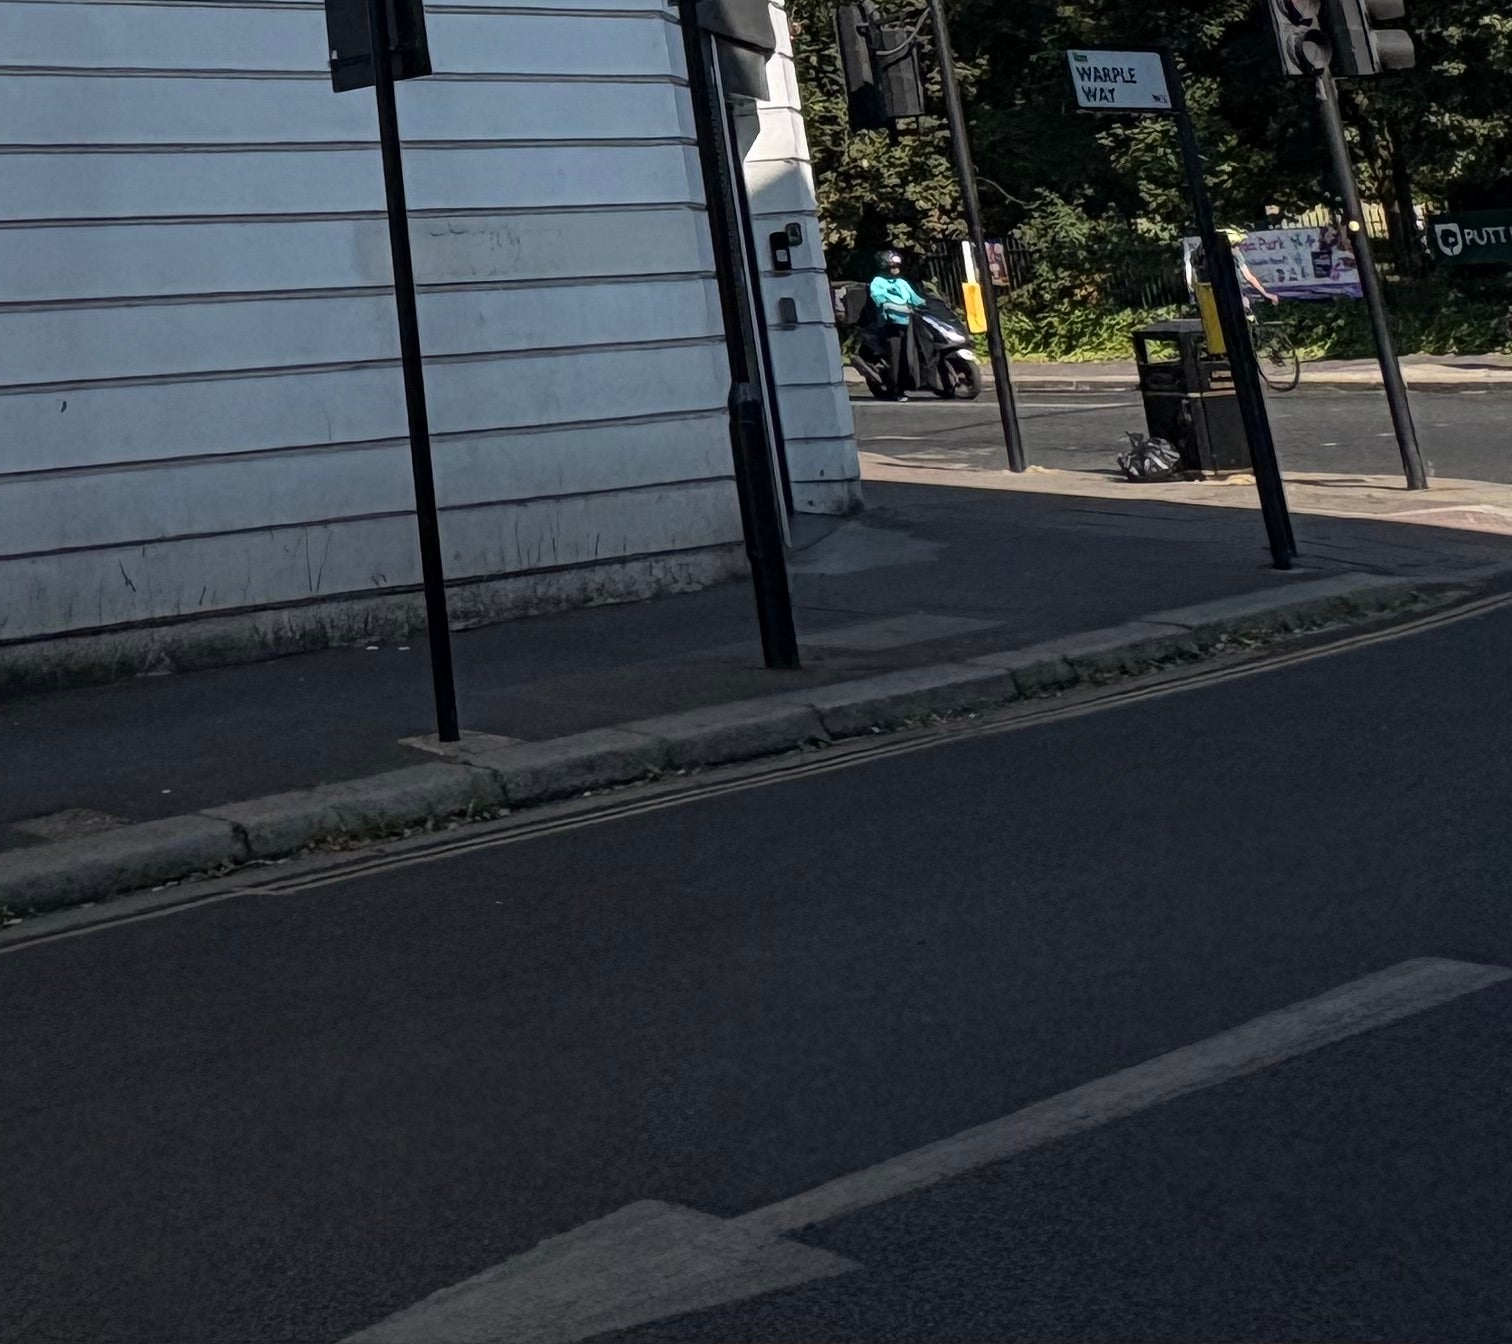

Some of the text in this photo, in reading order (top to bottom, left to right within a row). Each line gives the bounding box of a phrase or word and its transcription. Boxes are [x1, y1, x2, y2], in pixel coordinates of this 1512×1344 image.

[1075, 66, 1136, 83] WARPLE
[1081, 86, 1115, 103] WAY
[1464, 226, 1506, 245] PUTT
